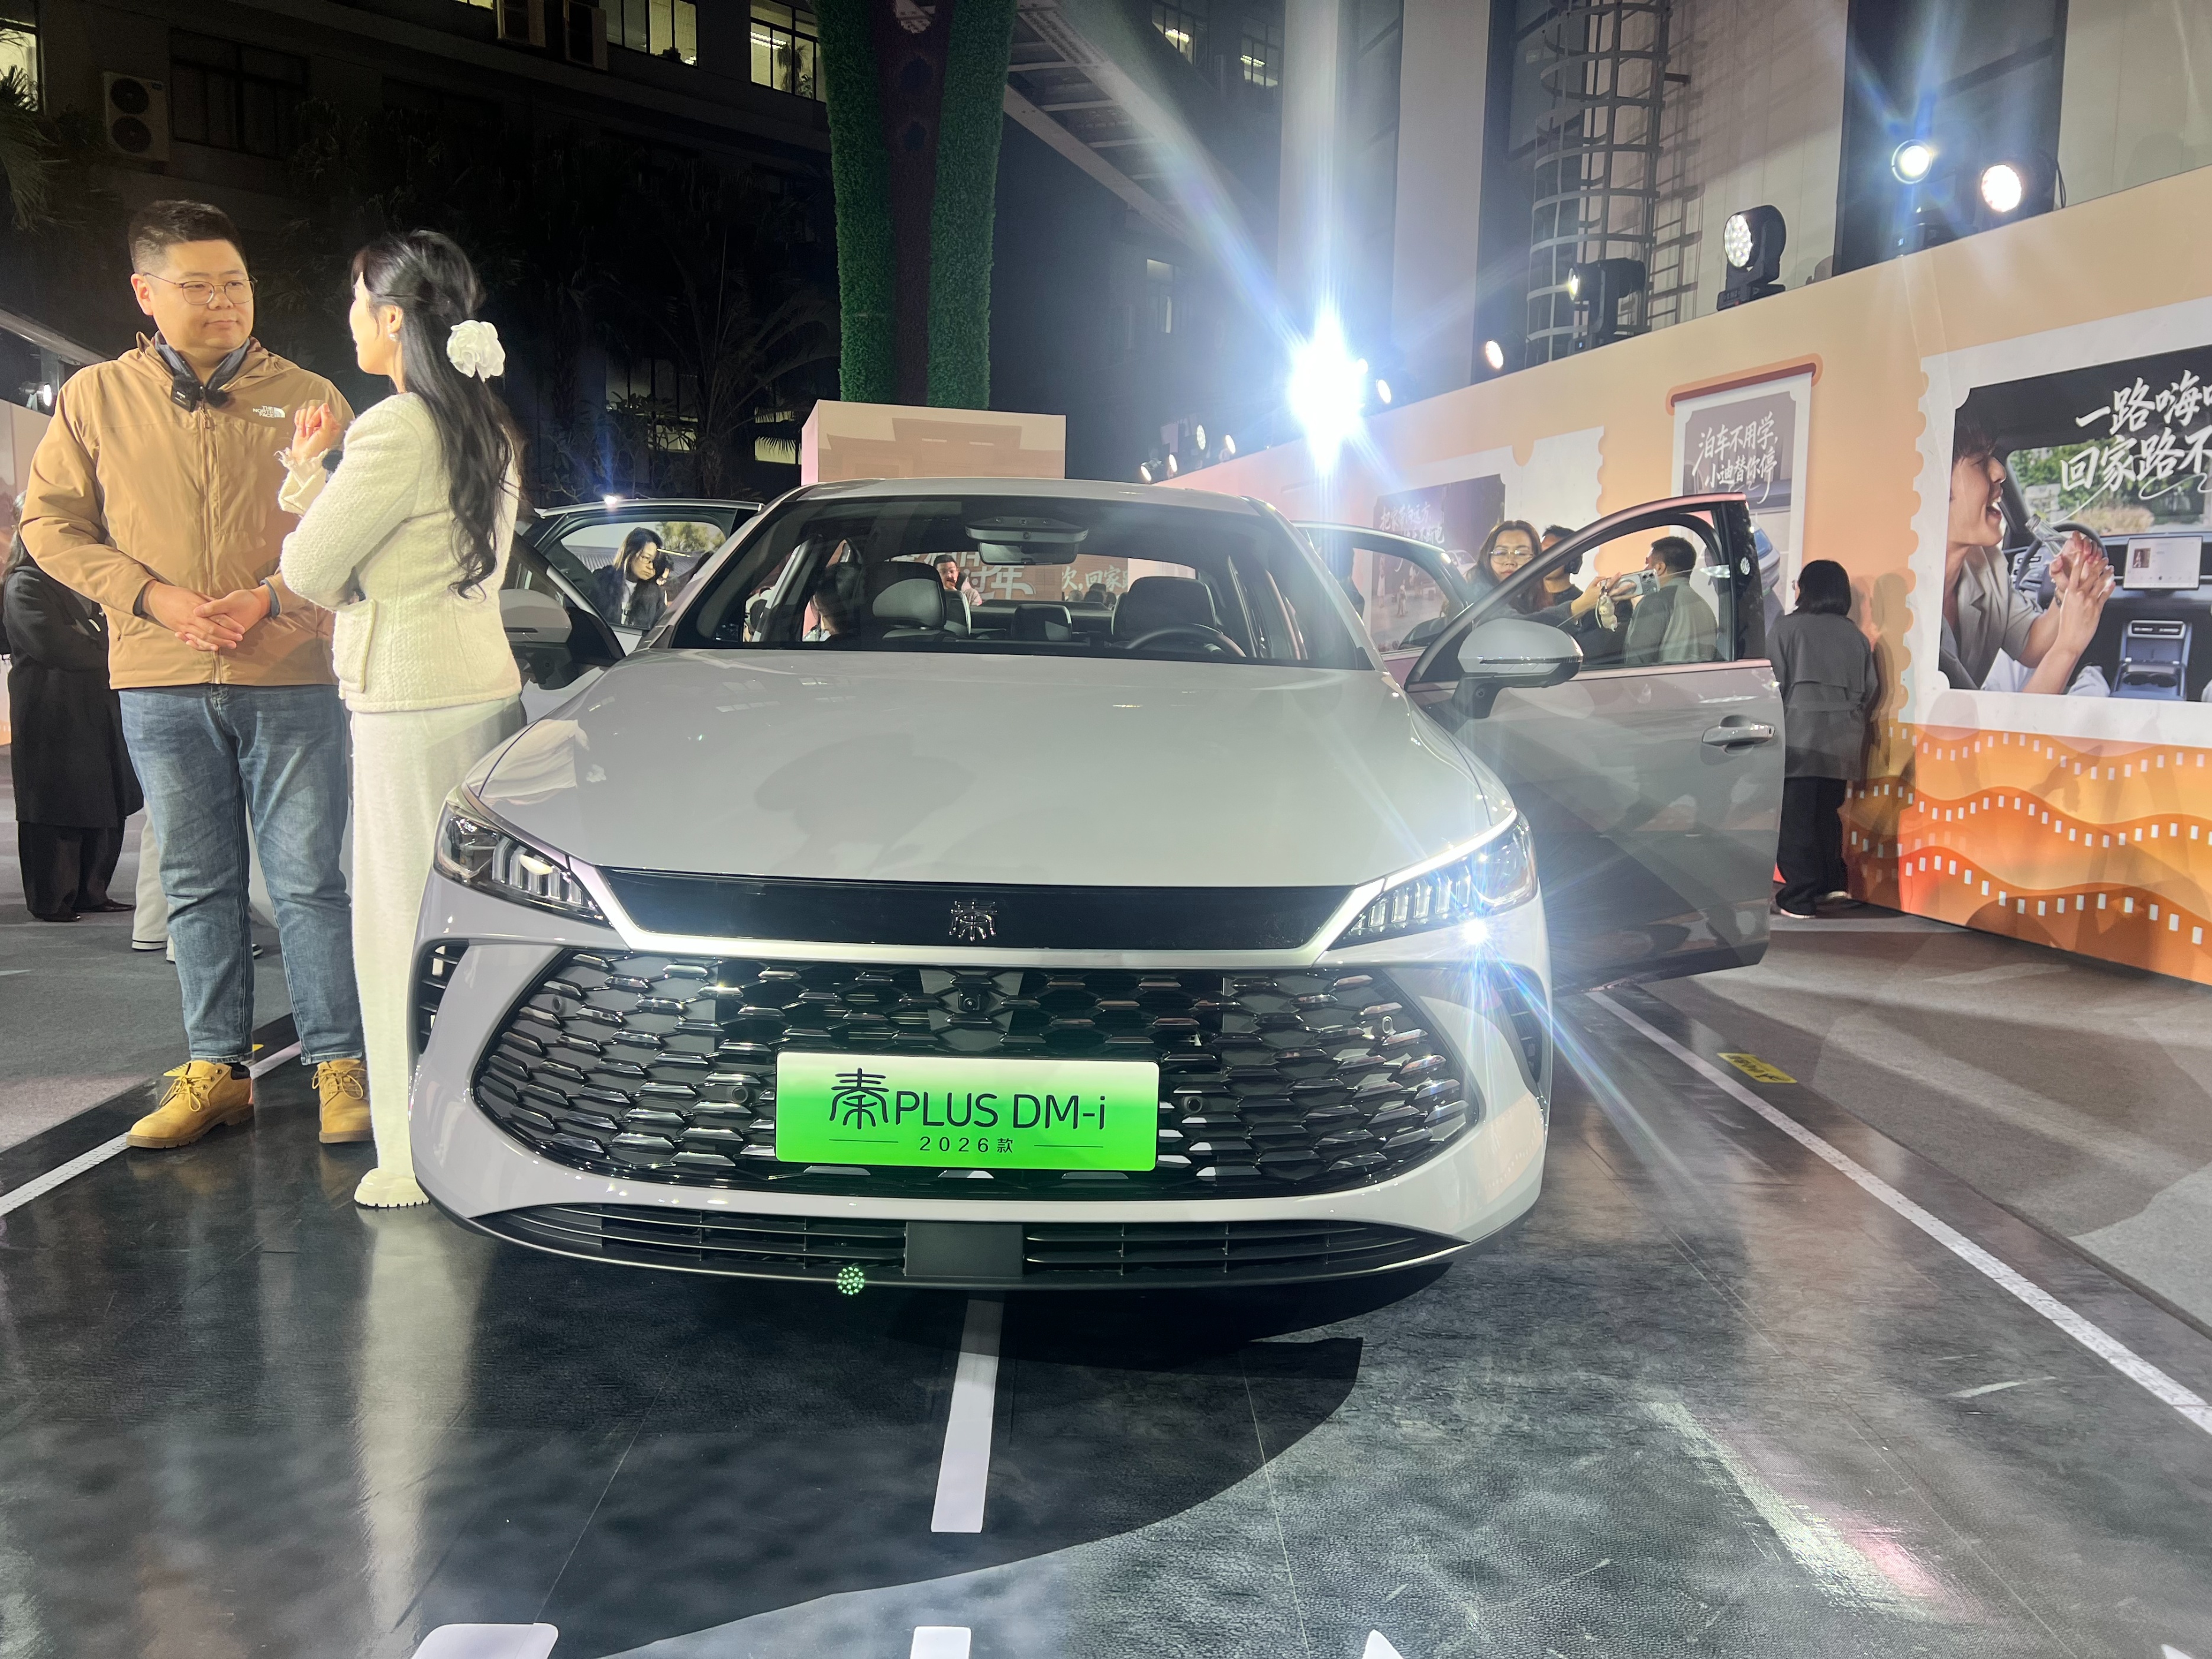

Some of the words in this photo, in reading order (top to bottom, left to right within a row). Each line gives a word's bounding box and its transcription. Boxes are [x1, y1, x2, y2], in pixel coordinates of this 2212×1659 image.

[1704, 446, 1778, 504] 小迪替你停
[1012, 1094, 1106, 1130] DM-i
[919, 1136, 1014, 1154] 2026款
